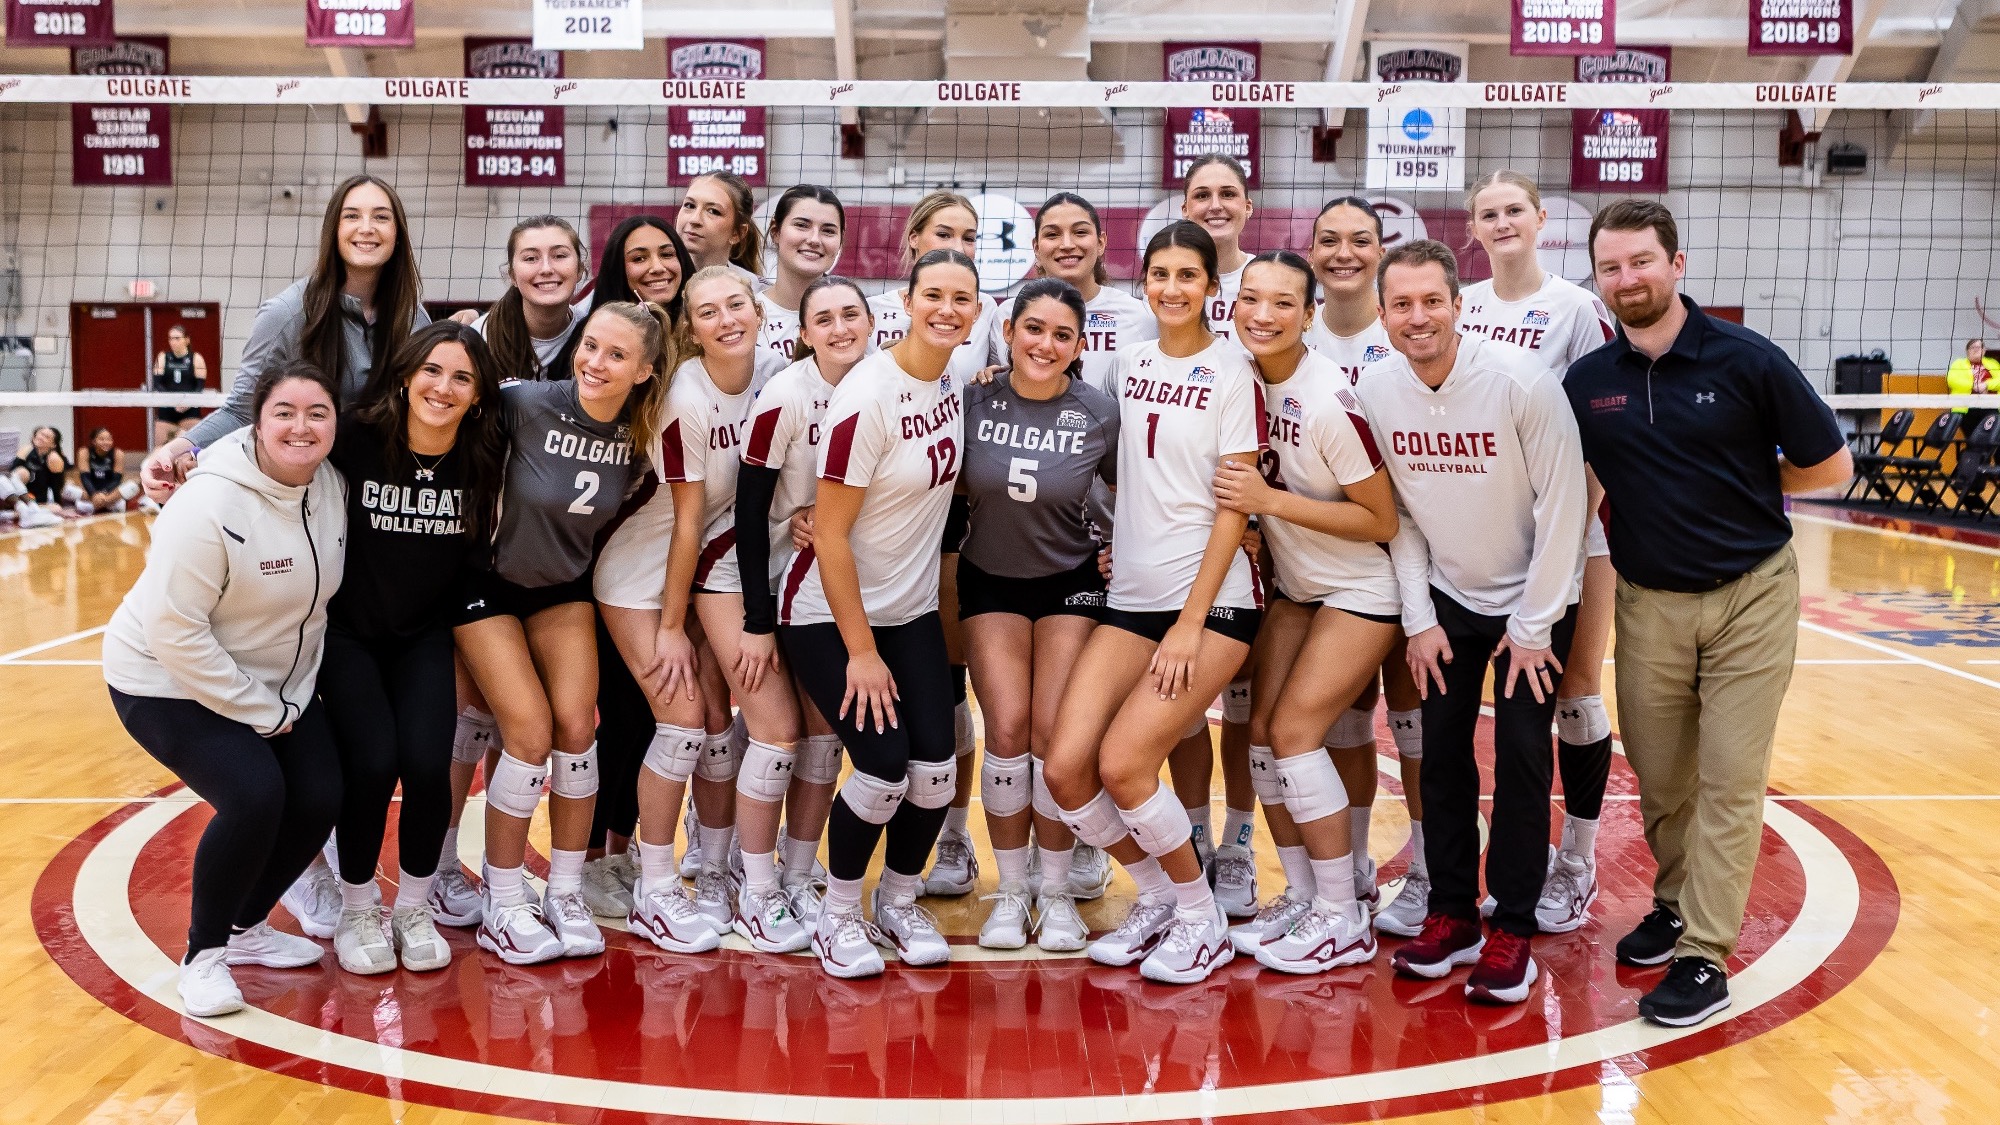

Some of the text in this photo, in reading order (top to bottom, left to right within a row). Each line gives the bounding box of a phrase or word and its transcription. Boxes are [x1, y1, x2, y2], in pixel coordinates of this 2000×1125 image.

[34, 12, 86, 35] 2012
[335, 12, 386, 35] 2012
[565, 17, 612, 34] 2012
[1523, 21, 1603, 44] 2018-19
[1761, 21, 1840, 43] 2018-19
[107, 79, 191, 97] COLGATE
[385, 80, 469, 98] COLGATE
[662, 81, 745, 99] COLGATE
[938, 83, 1021, 101] COLGATE
[1212, 84, 1294, 102] COLGATE
[1485, 84, 1567, 101] COLGATE
[1756, 85, 1837, 102] COLGATE
[1174, 133, 1250, 144] TOURNAMENT
[1583, 135, 1658, 147] TOURNAMENT
[1174, 144, 1249, 156] CHAMPIONS
[1378, 143, 1456, 157] TOURNAMENT
[1582, 147, 1658, 159] CHAMPIONS
[477, 155, 556, 176] 1993-94
[678, 155, 758, 175] 1994-95
[1395, 161, 1439, 178] 1995
[1599, 161, 1644, 182] 1995
[1125, 376, 1212, 411] COLGATE
[1591, 395, 1628, 409] COLGATE
[977, 419, 1087, 455] COLGATE
[1146, 412, 1160, 459] 1
[1392, 431, 1498, 457] COLGATE
[544, 429, 634, 466] COLGATE
[927, 437, 957, 490] 12
[1408, 462, 1488, 474] VOLLEYBALL
[1007, 457, 1040, 503] 5
[567, 470, 600, 515] 2
[370, 512, 465, 535] VOLLEYBAL
[260, 557, 294, 571] COLGATE
